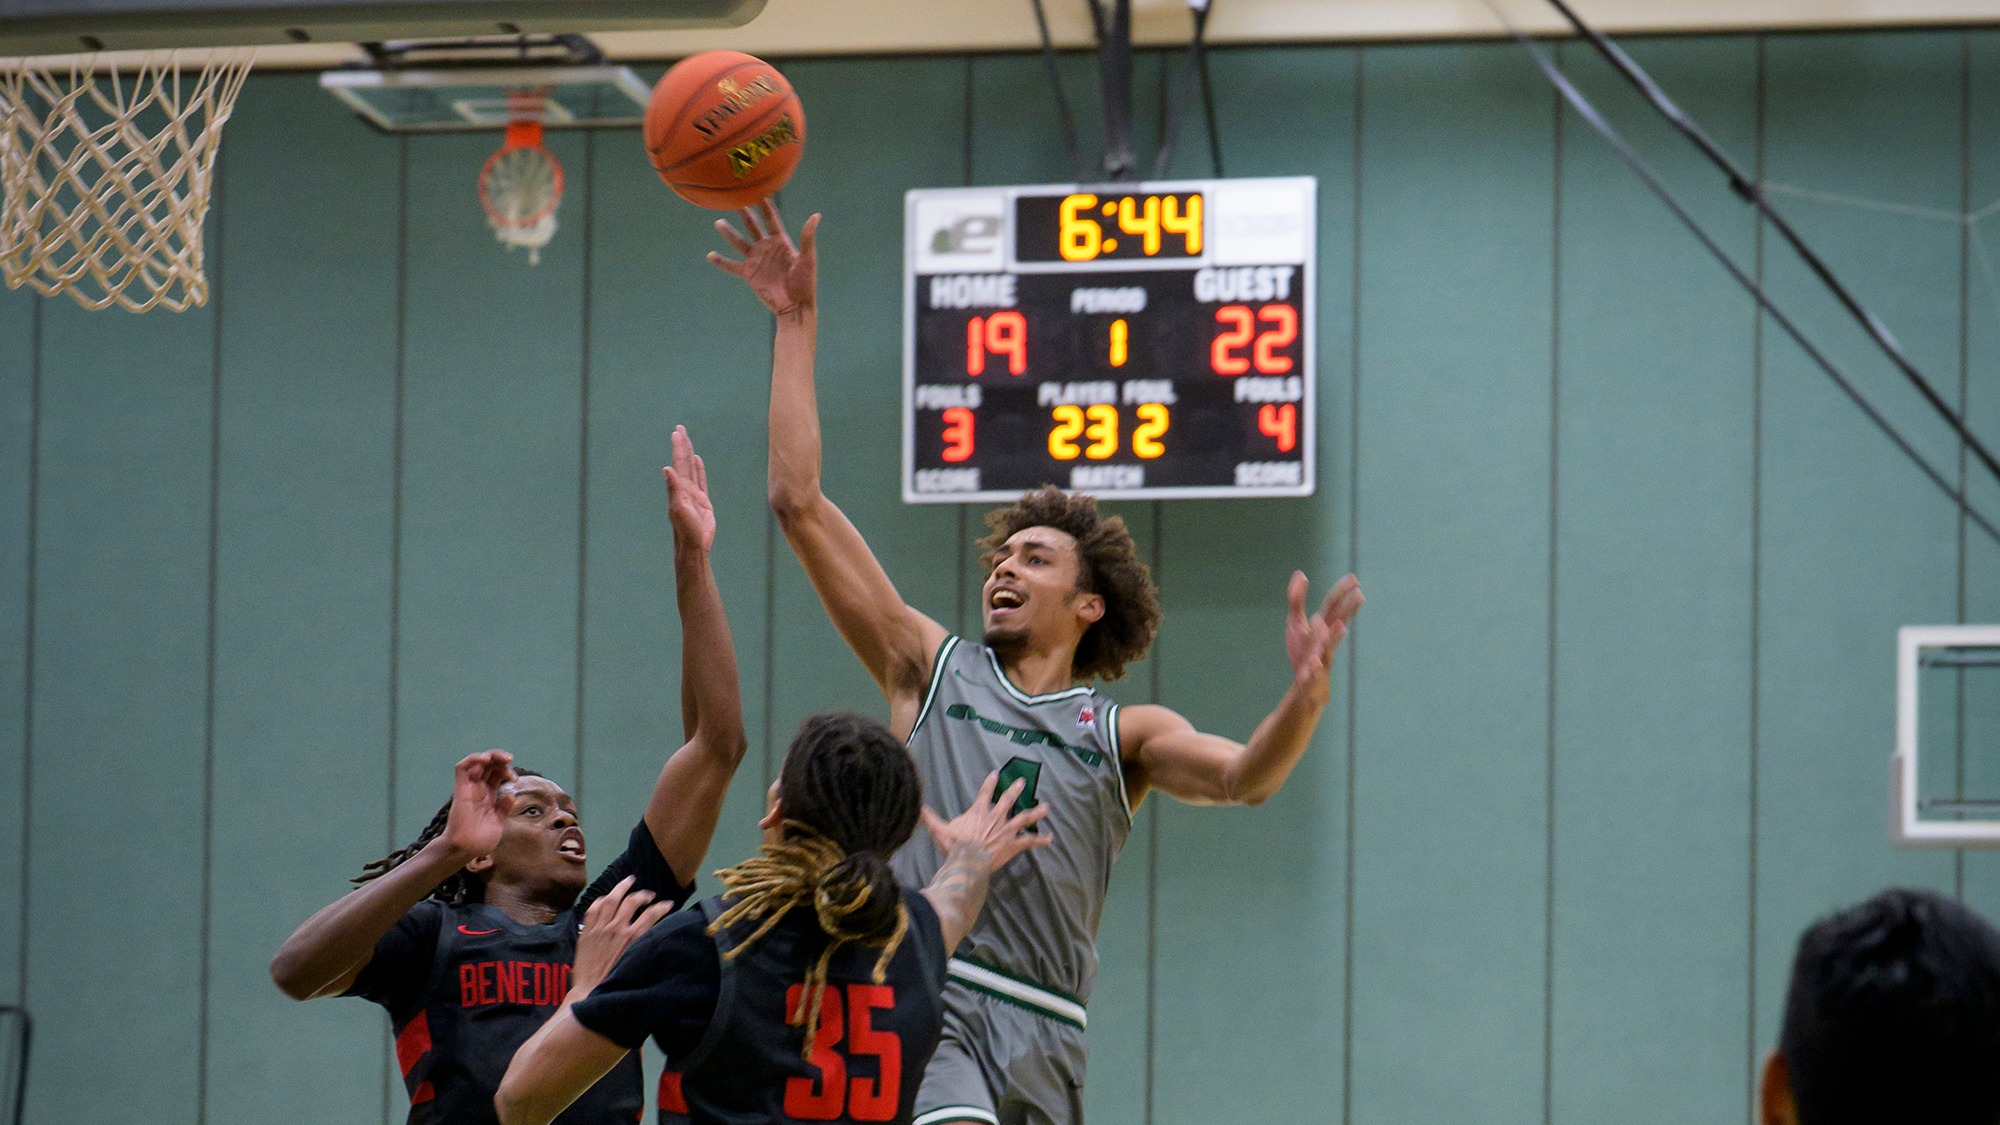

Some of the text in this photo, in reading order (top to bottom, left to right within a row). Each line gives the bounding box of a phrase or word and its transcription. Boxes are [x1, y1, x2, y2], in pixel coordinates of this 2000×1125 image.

[1060, 193, 1204, 262] 6:44
[930, 274, 1017, 309] HOME
[1070, 286, 1147, 314] PERIOD
[1194, 266, 1295, 302] GUEST
[966, 311, 1027, 376] 19
[1109, 318, 1128, 367] 1
[1210, 304, 1298, 375] 22
[916, 384, 983, 410] FOULS
[1038, 379, 1178, 407] PLAYER FOUL
[1234, 376, 1301, 403] FOULS
[941, 406, 975, 462] 3
[1047, 402, 1170, 460] 23 2
[1257, 403, 1297, 452] 4
[990, 756, 1043, 833] 4
[783, 983, 899, 1122] 35
